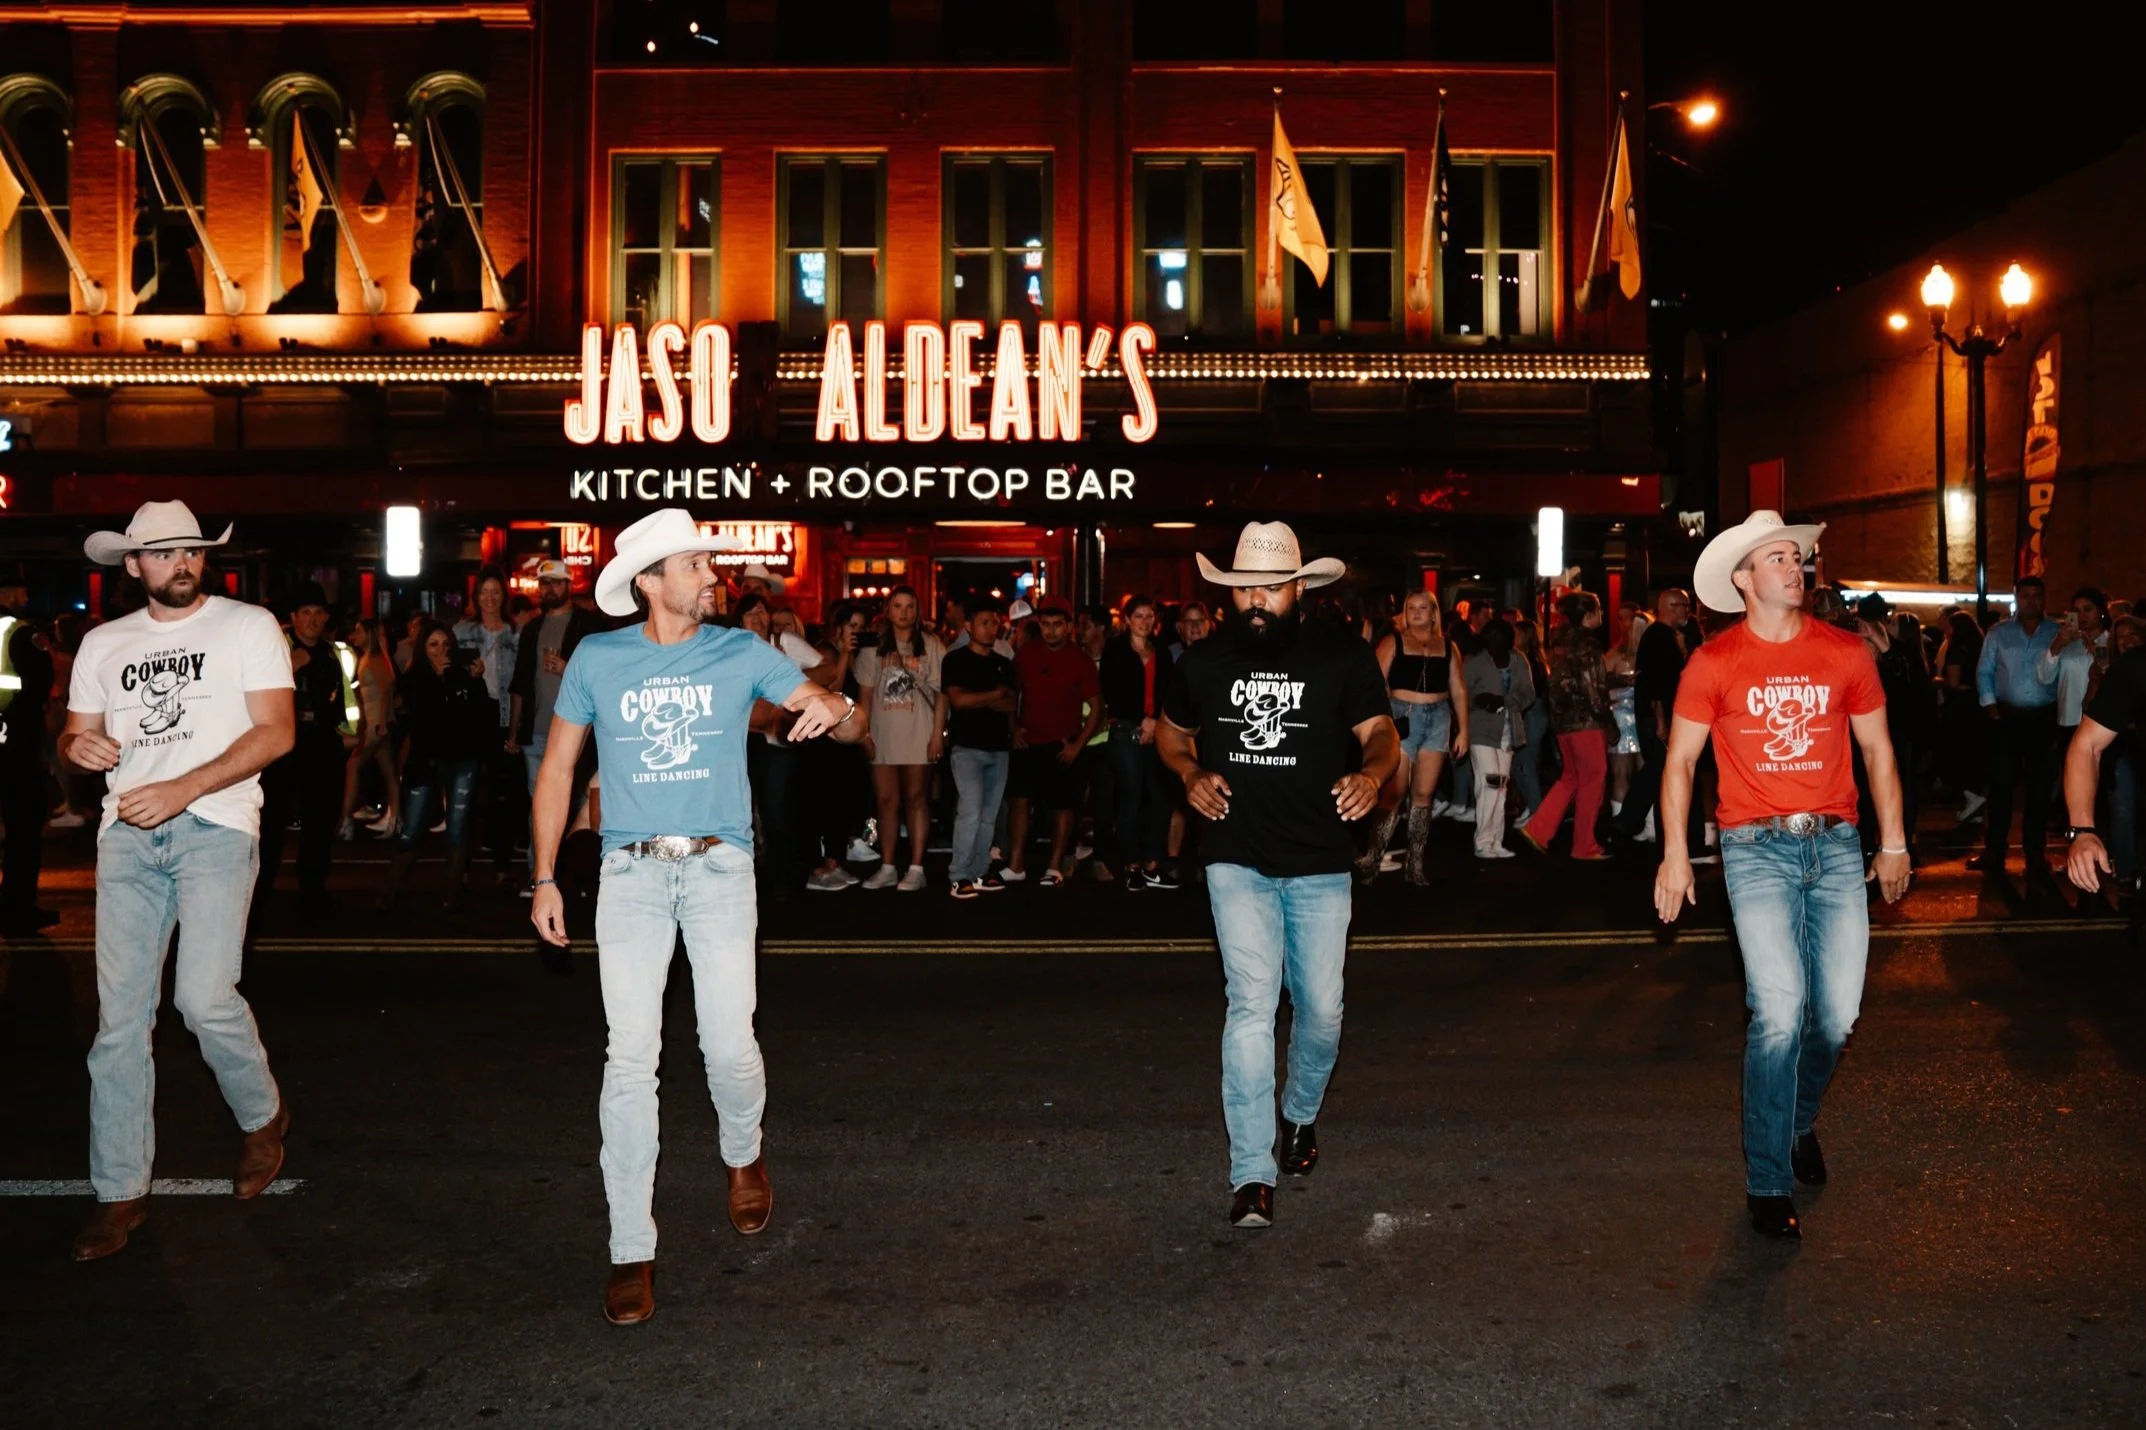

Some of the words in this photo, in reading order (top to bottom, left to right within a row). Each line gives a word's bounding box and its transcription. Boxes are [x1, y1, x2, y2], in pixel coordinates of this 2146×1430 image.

[815, 320, 1158, 444] ALDEAN'S
[570, 467, 752, 501] KITCHEN
[808, 466, 1030, 500] ROOFTOP
[1045, 468, 1136, 501] BAR
[144, 648, 186, 659] URBAN
[121, 653, 205, 691] COWBOY
[643, 676, 690, 686] URBAN
[620, 685, 712, 721] COWBOY
[1230, 680, 1305, 709] COWBOY
[1746, 685, 1830, 716] COWBOY
[1229, 752, 1251, 764] LINE
[1252, 755, 1296, 766] DANCING
[1755, 762, 1779, 772] LINE
[1781, 761, 1823, 771] DANCING
[632, 773, 657, 783] LINE
[659, 768, 710, 781] DANCING
